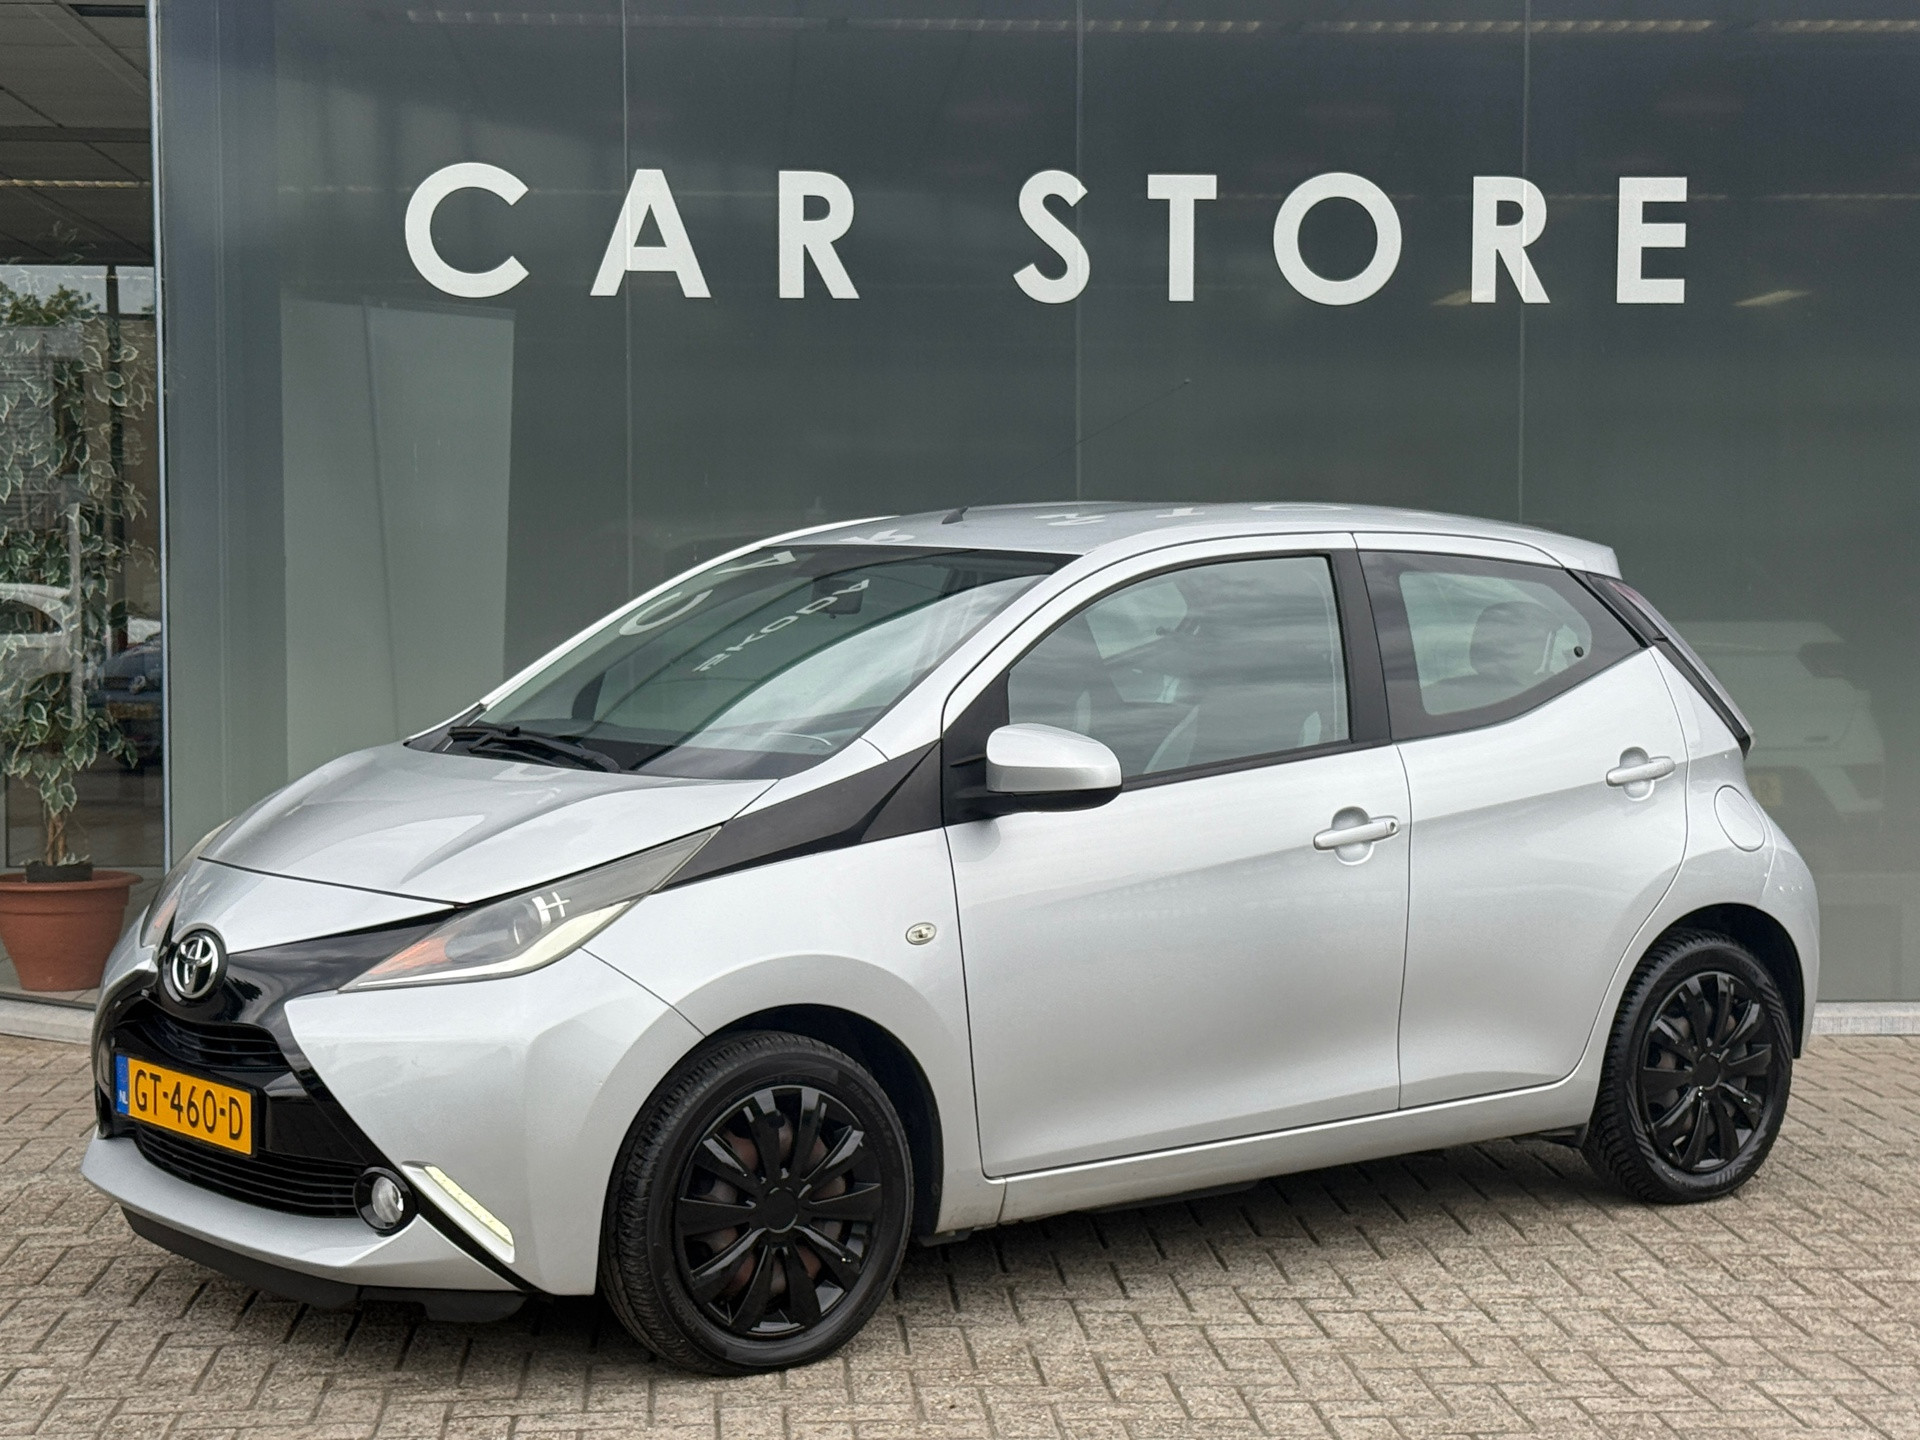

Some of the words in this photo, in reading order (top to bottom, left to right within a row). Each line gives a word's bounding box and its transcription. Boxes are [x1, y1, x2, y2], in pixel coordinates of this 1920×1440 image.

[405, 163, 860, 299] CAR
[1014, 170, 1689, 306] STORE
[119, 1089, 129, 1105] NL
[134, 1069, 244, 1141] GT-460-D
